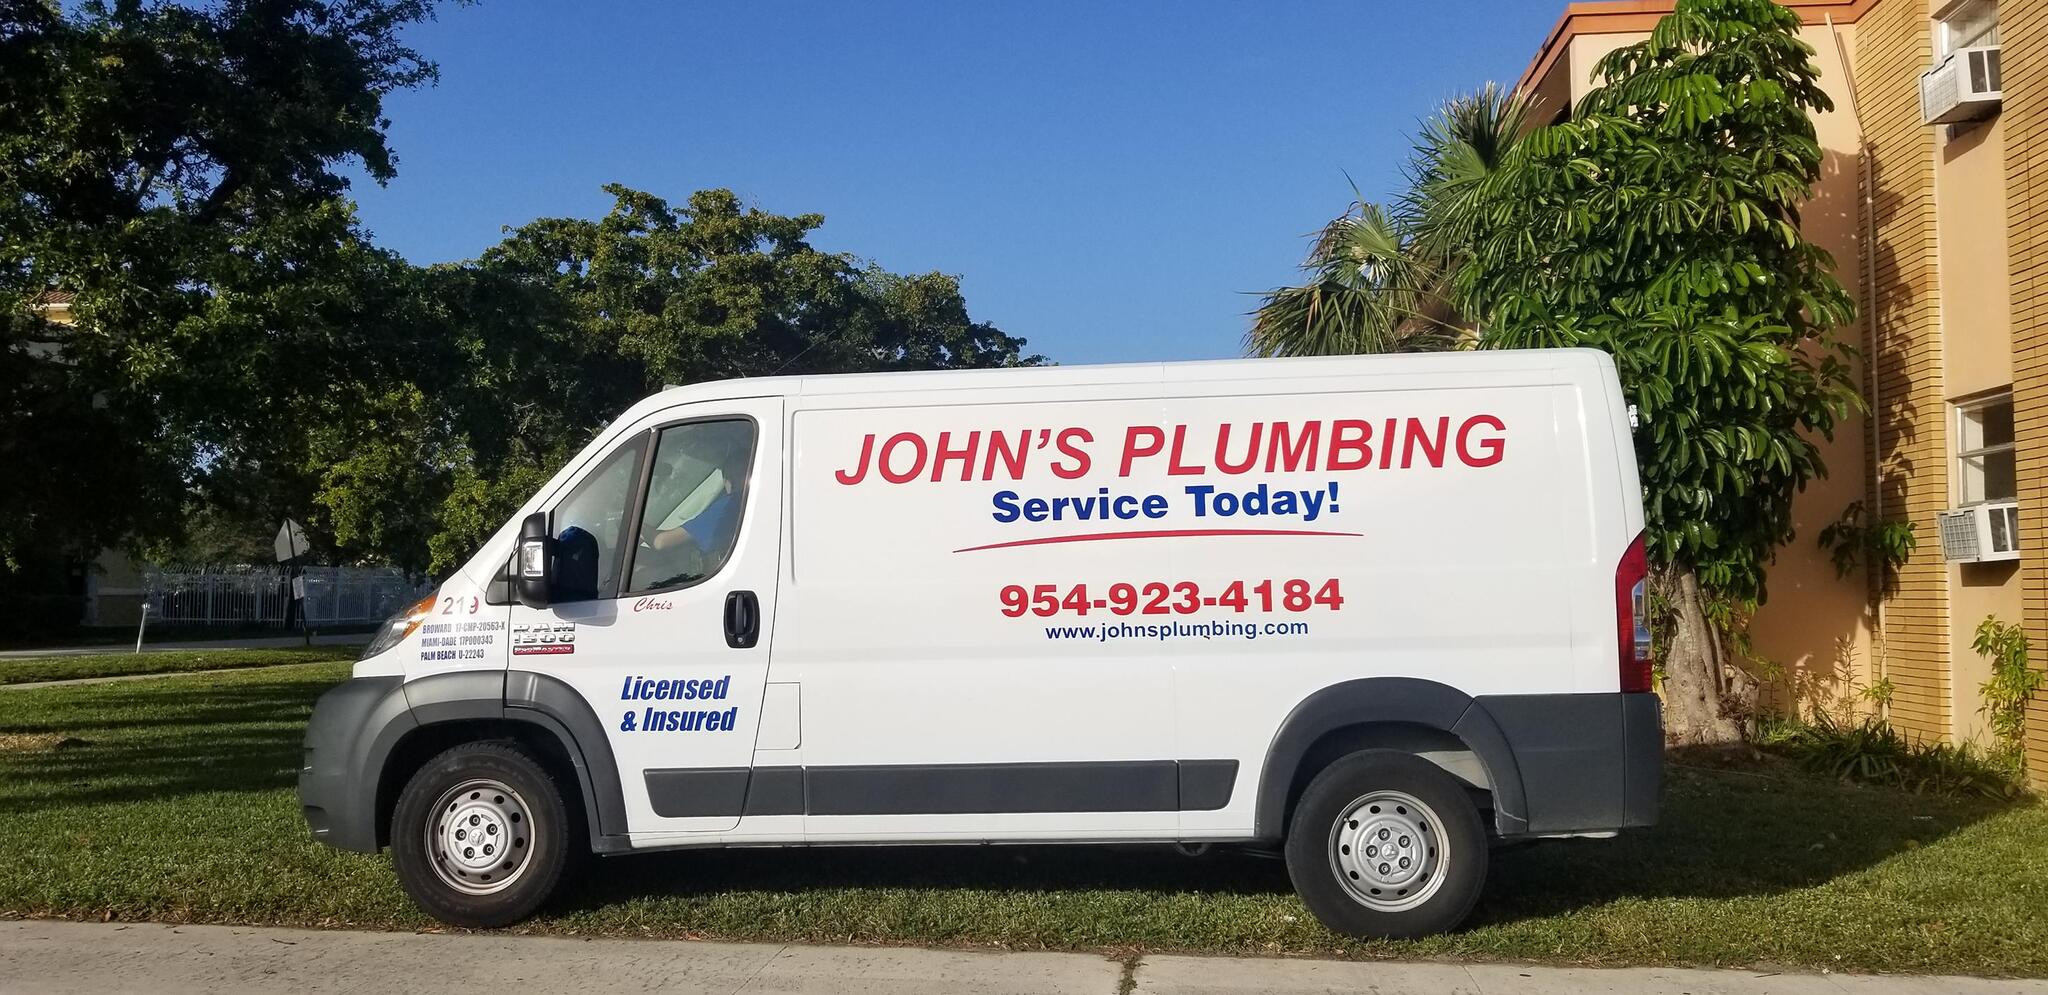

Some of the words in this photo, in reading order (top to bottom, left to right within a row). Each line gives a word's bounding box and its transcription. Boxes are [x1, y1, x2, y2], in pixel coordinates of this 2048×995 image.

[835, 427, 1095, 485] JOHN'S
[1119, 414, 1507, 477] PLUMBING
[992, 488, 1169, 523] Service
[1185, 481, 1340, 521] Today!
[633, 597, 674, 613] Chris
[999, 577, 1344, 619] 954-923-4184
[422, 623, 452, 634] BROWARD
[513, 622, 576, 633] RAM
[1045, 620, 1309, 642] www.johnsplumbing.com
[421, 636, 457, 647] MIAMI-DADE
[513, 633, 576, 643] 1500
[420, 651, 436, 661] PALM
[437, 650, 457, 660] BEACH
[458, 649, 484, 659] U-22243
[621, 675, 731, 700] Licensed
[620, 710, 637, 731] &
[642, 707, 738, 731] Insured
